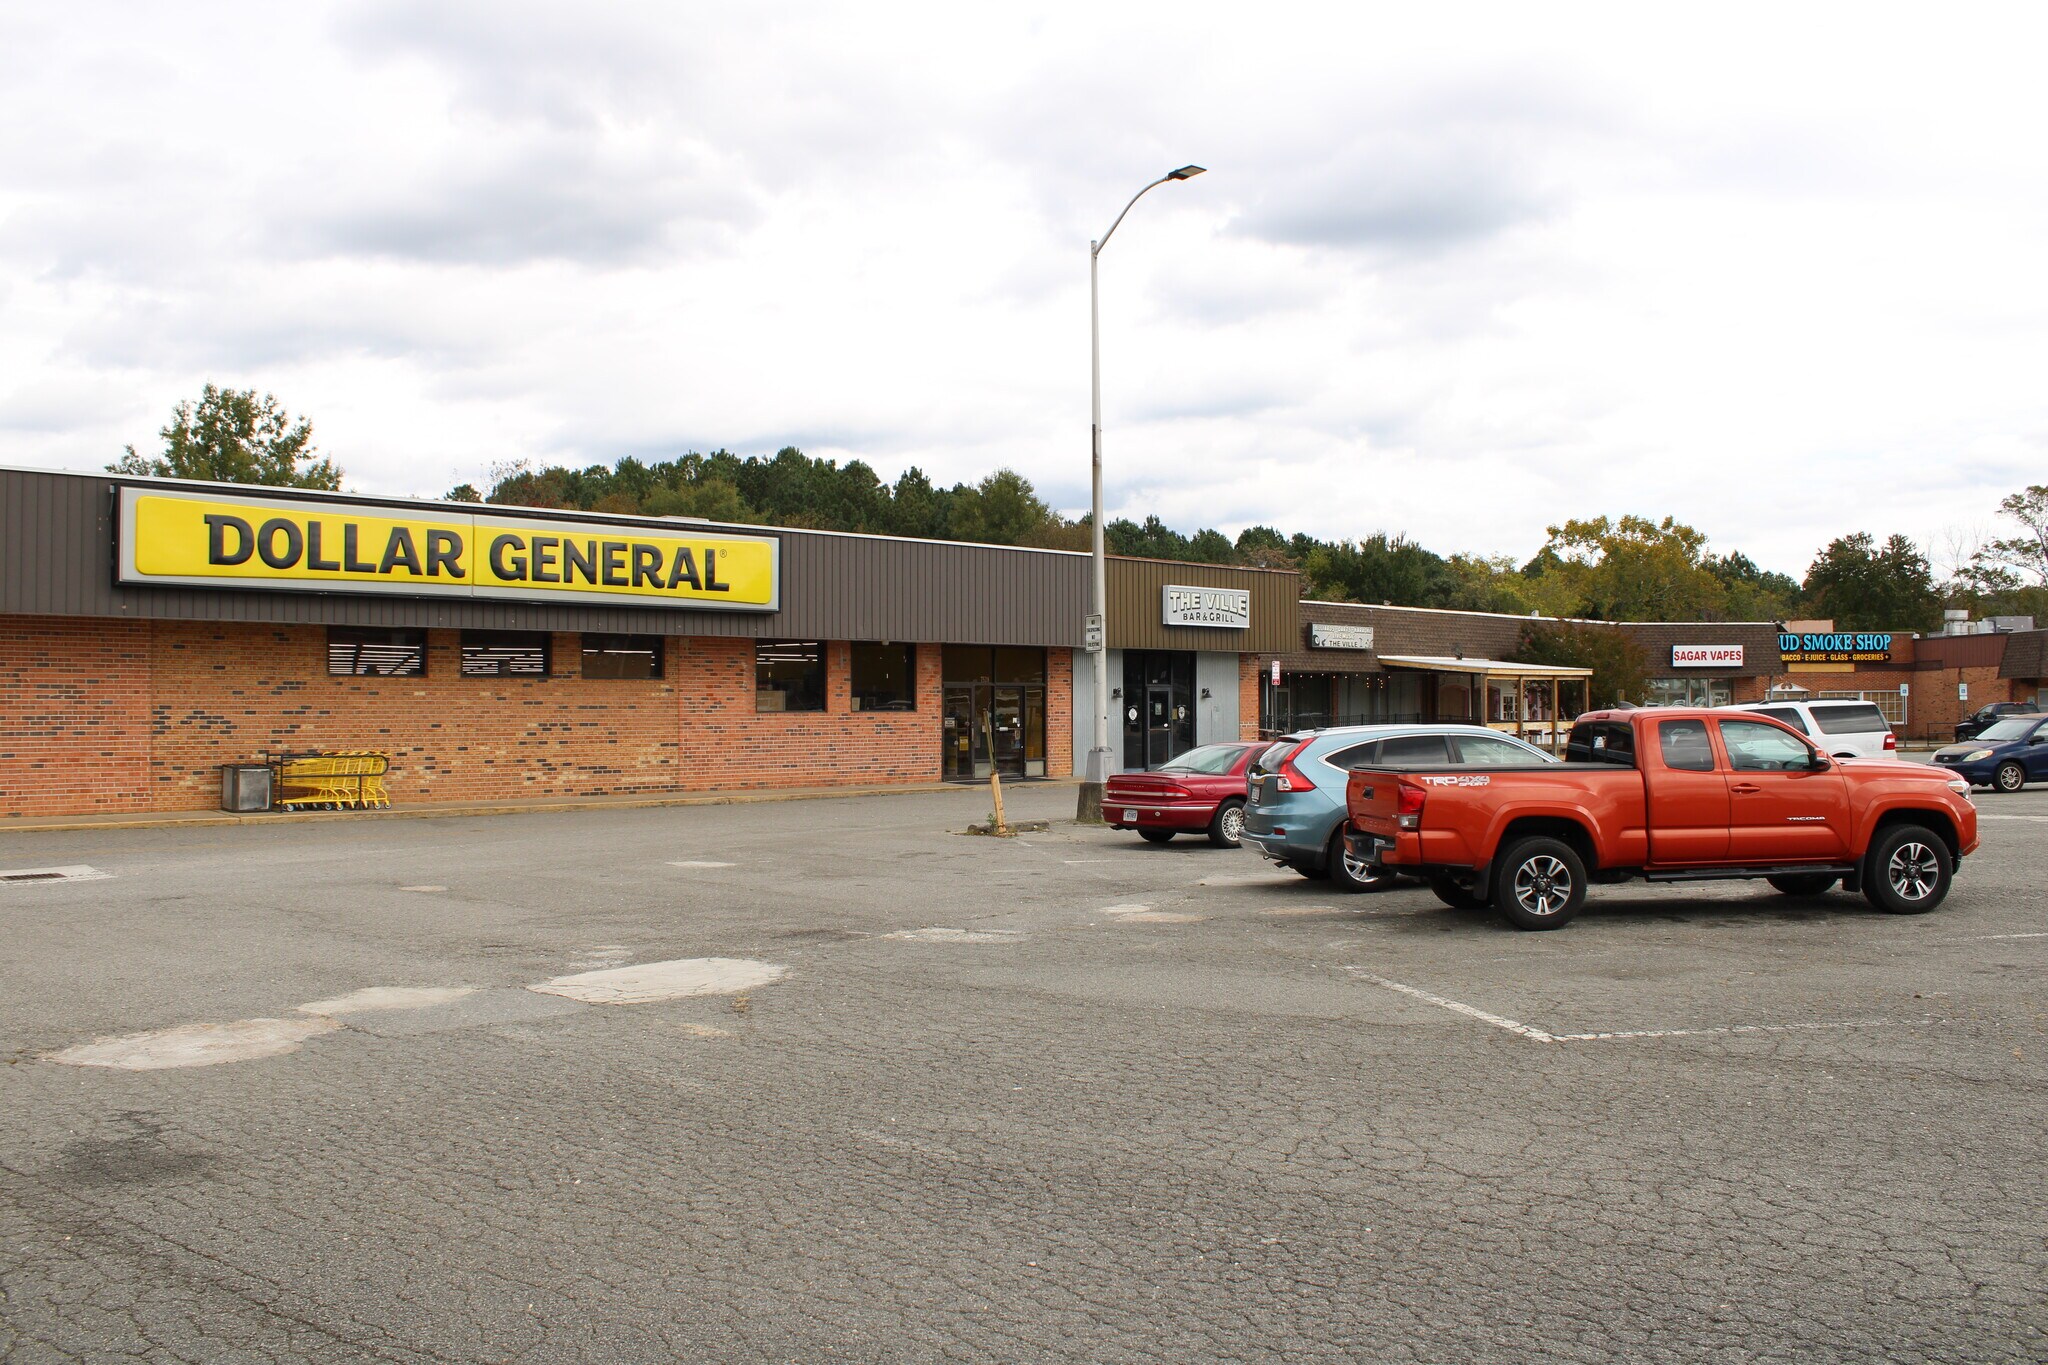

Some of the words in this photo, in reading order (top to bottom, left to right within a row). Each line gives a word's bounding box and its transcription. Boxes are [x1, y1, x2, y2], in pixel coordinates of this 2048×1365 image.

[204, 513, 466, 578] DOLLAR
[489, 533, 730, 592] GENERAL
[1170, 590, 1201, 613] THE
[1204, 592, 1247, 618] VILLE
[1778, 634, 1800, 651] UD
[1803, 634, 1853, 651] SMOKE
[1856, 634, 1891, 650] SHOP
[1674, 650, 1707, 661] SAGAR
[1710, 650, 1742, 661] VAPES
[1852, 653, 1885, 661] GROCERIES
[1421, 776, 1458, 787] TRD
